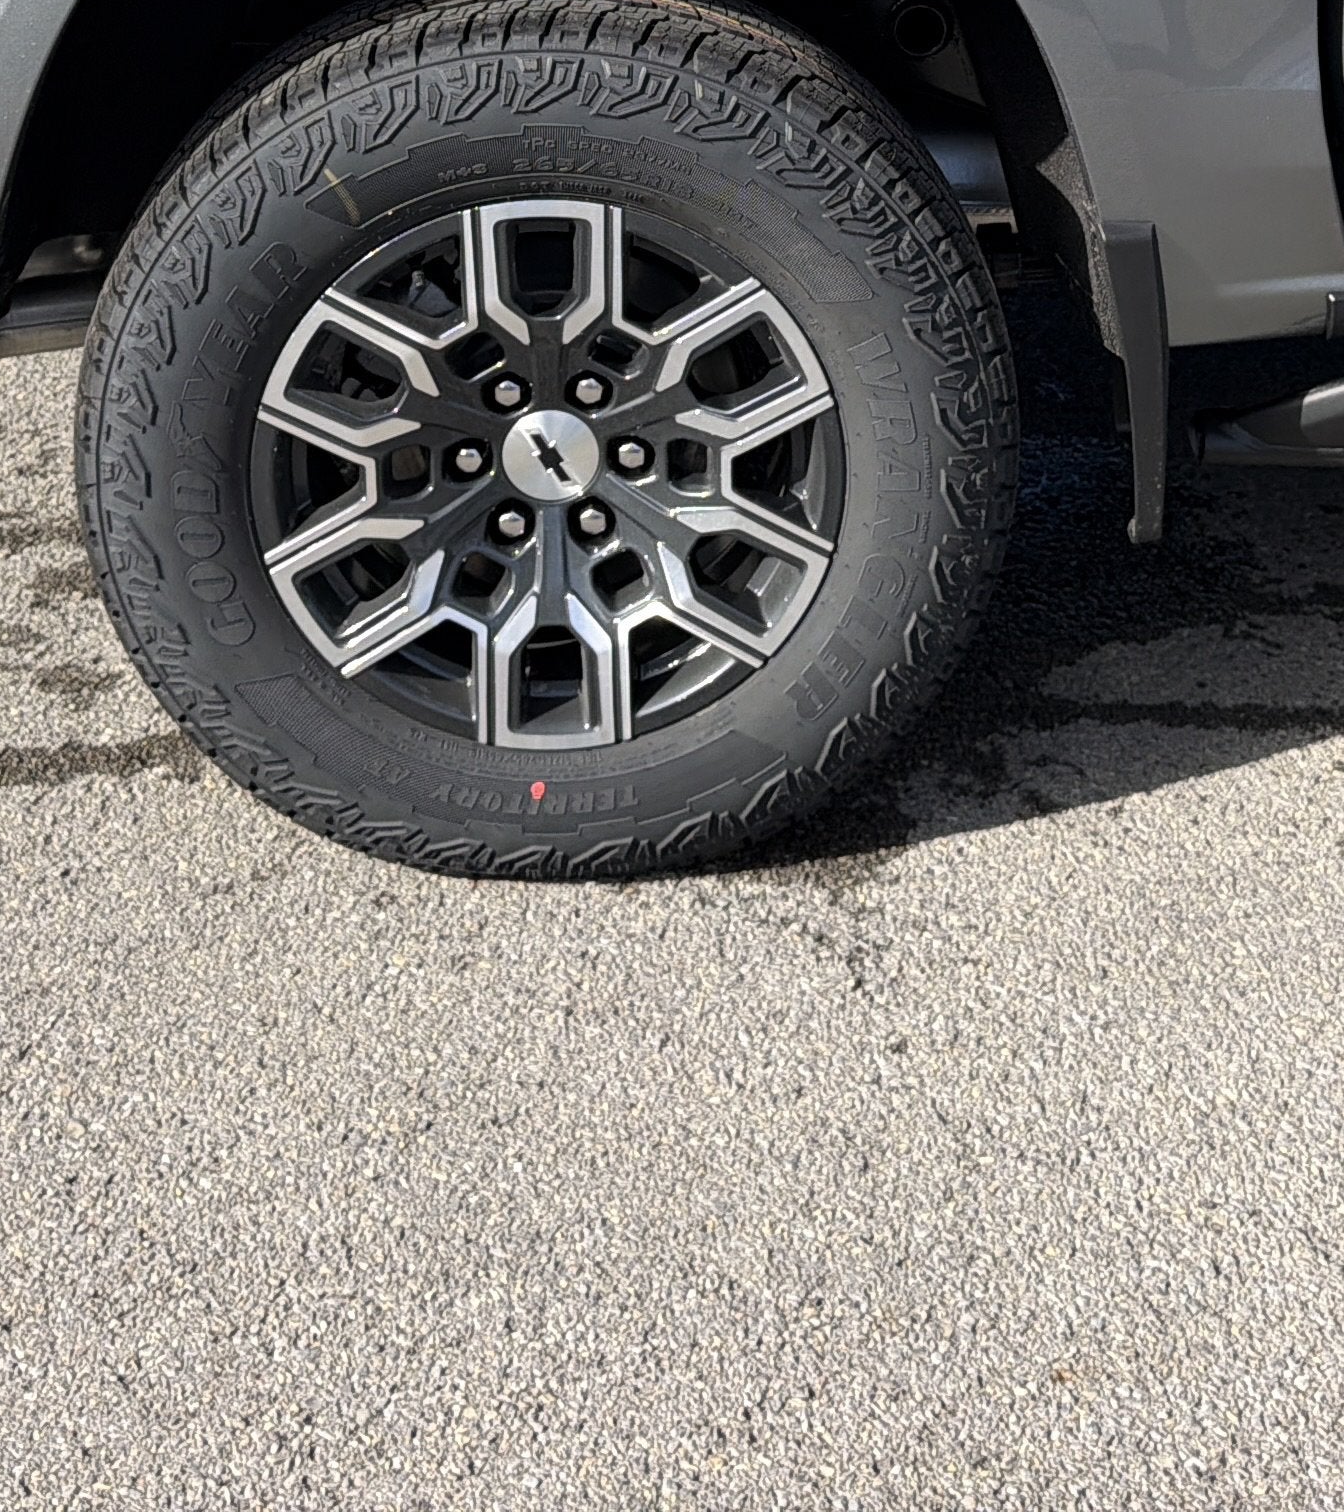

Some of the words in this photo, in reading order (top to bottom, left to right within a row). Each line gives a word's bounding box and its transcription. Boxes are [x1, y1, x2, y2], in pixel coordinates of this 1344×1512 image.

[512, 155, 695, 199] 265/65R18
[171, 236, 312, 648] GOODYEAR
[778, 330, 928, 724] WRANGLER
[429, 782, 639, 817] TERRITORY
